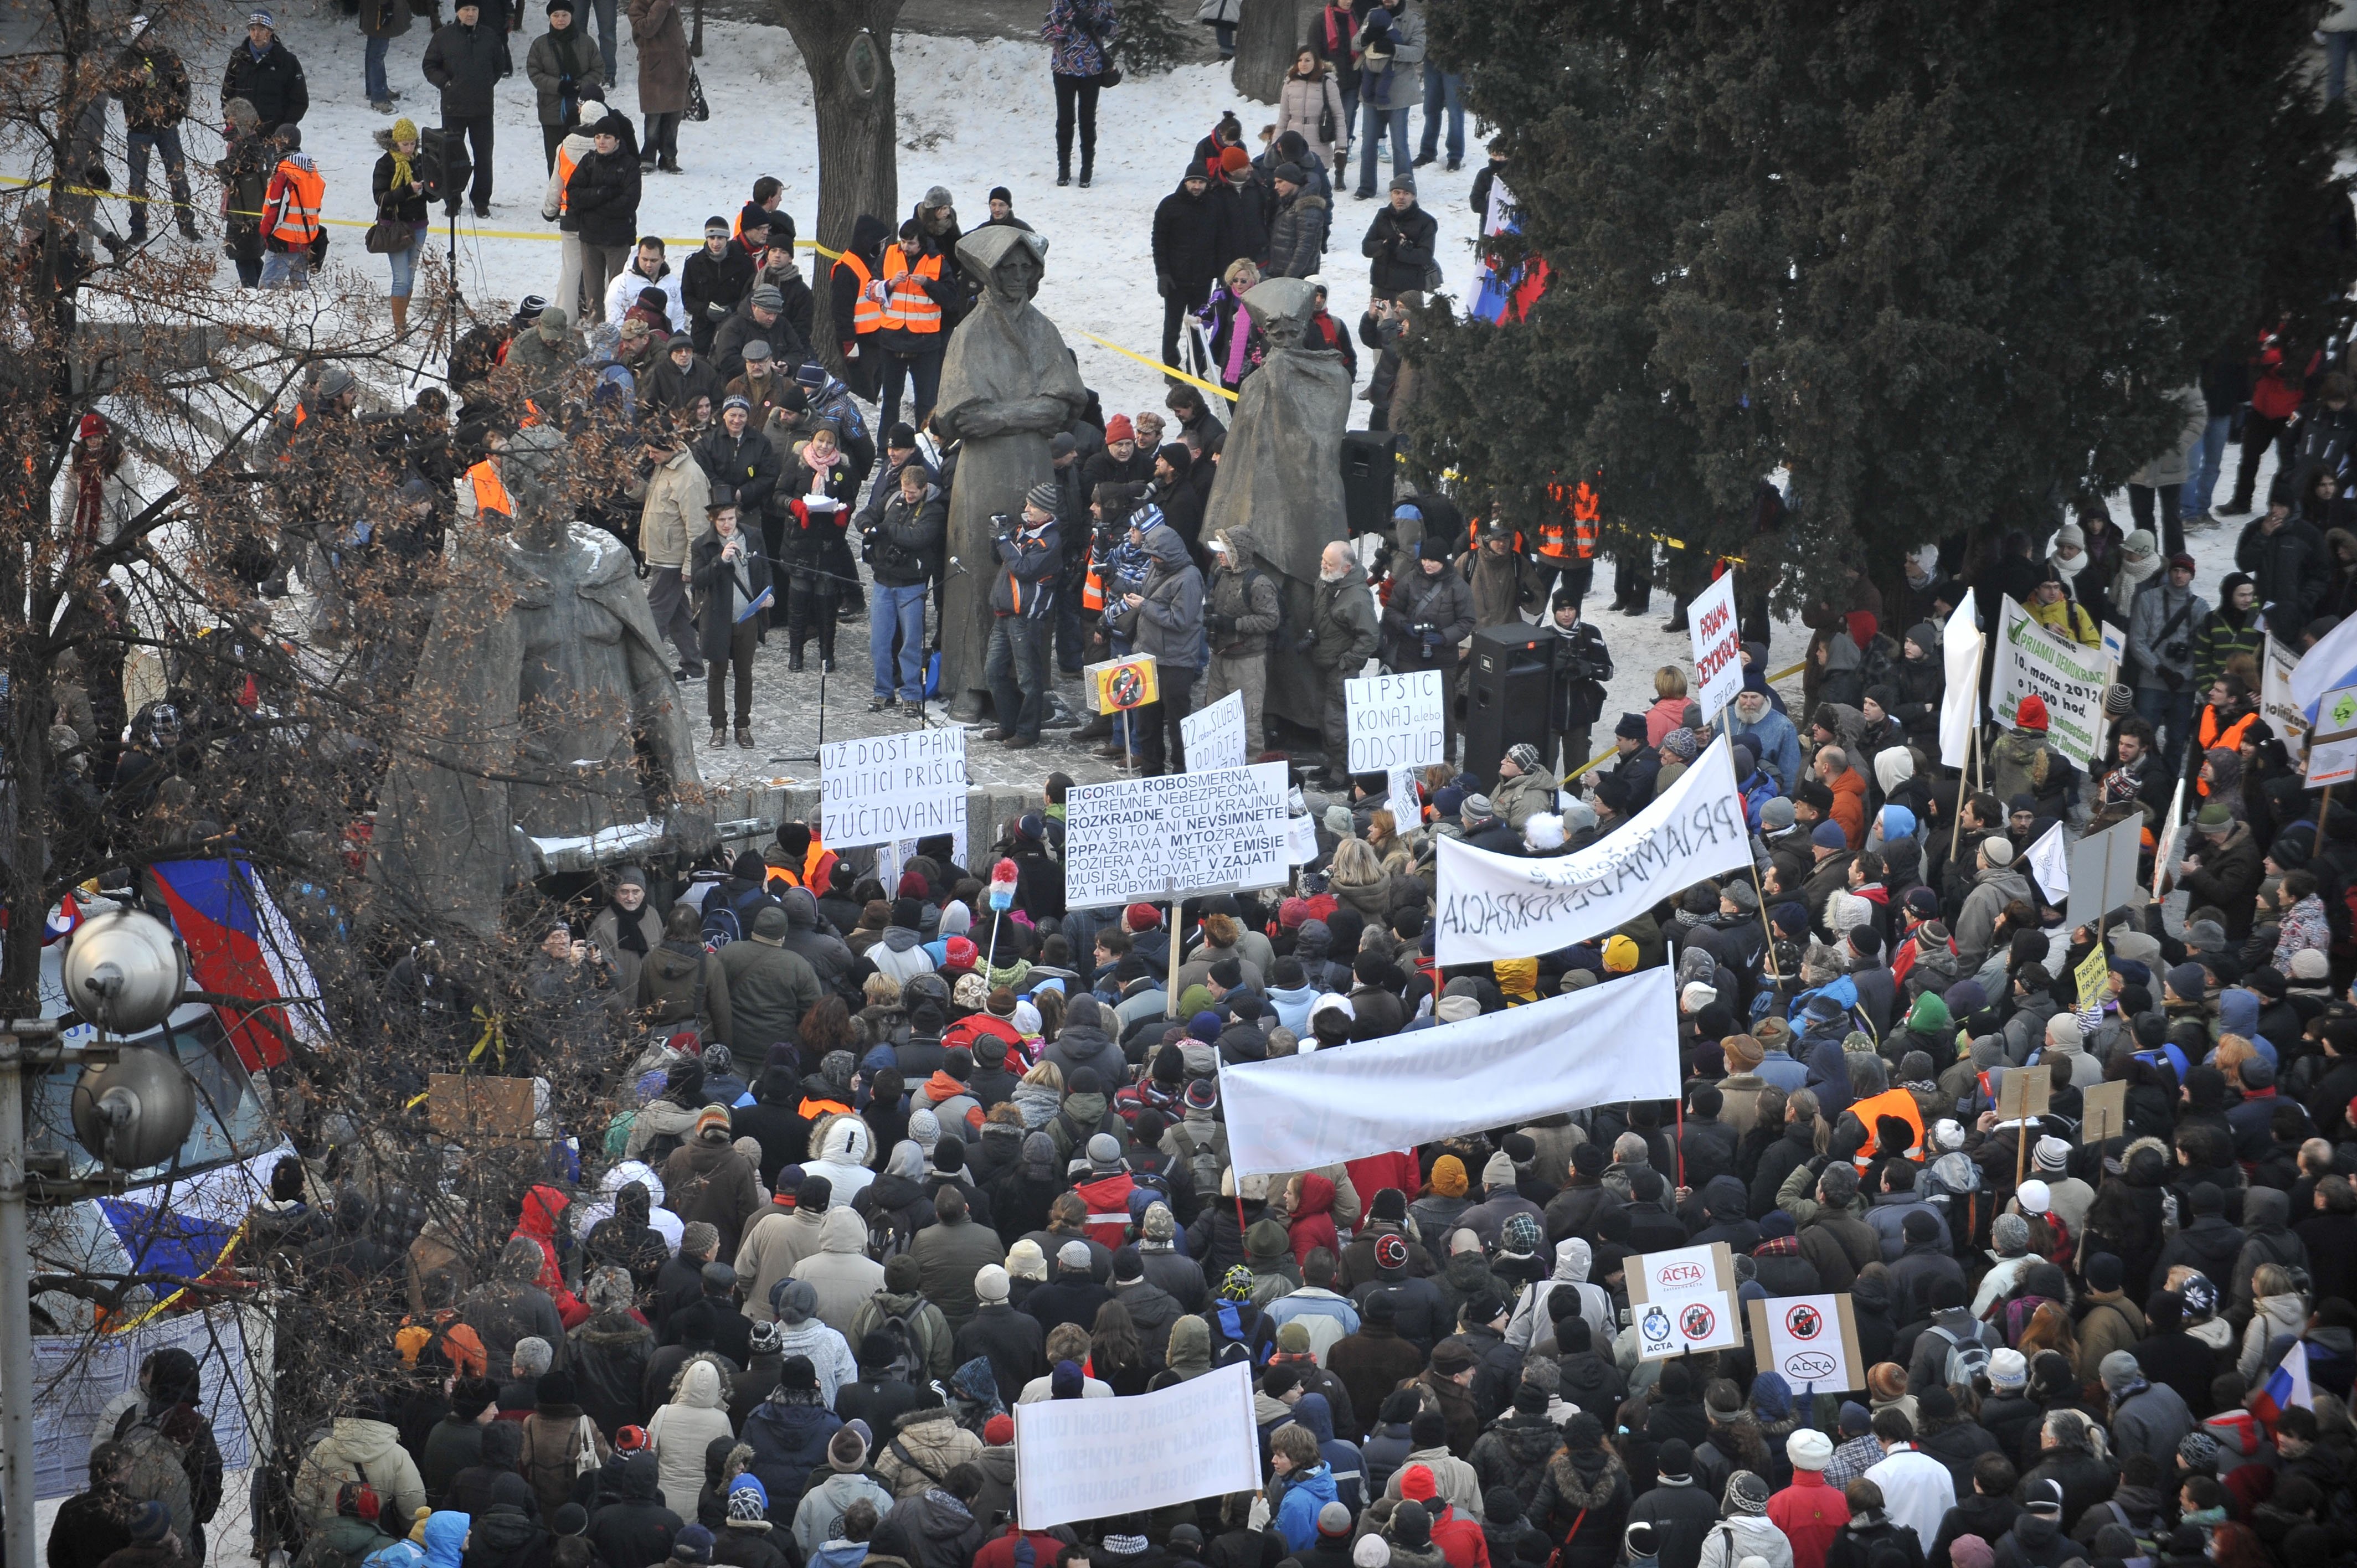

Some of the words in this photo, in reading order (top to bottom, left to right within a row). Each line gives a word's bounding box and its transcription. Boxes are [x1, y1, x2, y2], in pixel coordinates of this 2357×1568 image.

[1700, 599, 1730, 646] PRIAMA
[2020, 633, 2054, 663] PRIAMU
[2055, 653, 2106, 685] DEMOKRACI
[2014, 653, 2027, 672] 10.
[2030, 667, 2060, 692] marca
[2065, 683, 2097, 703] 2012
[2018, 678, 2024, 688] o
[2027, 681, 2057, 706] 12:00
[2062, 697, 2086, 718] hod.
[1182, 719, 1196, 749] 22
[1198, 724, 1212, 741] rokov
[1357, 706, 1411, 731] KONAJ
[1414, 704, 1440, 722] alebo
[823, 741, 847, 770] UŽ
[858, 733, 909, 765] DOSŤ
[1196, 731, 1237, 769] ODÍĎTE
[1352, 726, 1443, 770] ODSTÚP
[2059, 731, 2091, 764] Slovensk
[905, 757, 965, 788] PRIŠLO
[1068, 782, 1138, 801] FIGORILA
[1143, 767, 1252, 793] ROBOSMERNÁ
[1068, 795, 1152, 816] EXTRÉMNE
[1159, 781, 1258, 805] NEBEZPEČNÁ
[1263, 781, 1265, 792] !
[1068, 808, 1164, 831] ROZKRADNE
[1171, 800, 1210, 818] CELÚ
[1216, 793, 1280, 813] KRAJINU
[824, 792, 965, 841] ZÚČTOVANIE
[1068, 832, 1078, 844] A
[1083, 828, 1103, 842] VY
[1108, 827, 1121, 840] SI
[1128, 823, 1149, 837] TO
[1155, 820, 1180, 834] ANI
[1187, 806, 1288, 831] NEVŠIMNETE!
[881, 850, 891, 863] NA
[898, 842, 917, 855] REDA
[1068, 835, 1162, 858] PPPAŽRAVÁ
[1171, 822, 1265, 847] MÝTOŽRAVÁ
[1068, 854, 1134, 871] POŽIERA
[1141, 851, 1159, 864] AJ
[1167, 842, 1226, 861] VŠETKY
[1234, 835, 1284, 853] EMISIE
[1068, 868, 1104, 886] MUSÍ
[1110, 868, 1130, 881] SA
[1138, 858, 1201, 878] CHOVAŤ
[1208, 858, 1218, 870] V
[1223, 848, 1275, 868] ZAJATÍ
[1068, 886, 1088, 900] ZA
[1095, 878, 1165, 896] HRUBÝMI
[1174, 868, 1242, 888] MREŽAMI
[1248, 866, 1250, 879] !
[2076, 950, 2103, 981] TRESTNO
[2081, 964, 2106, 993] PRÁVNA
[1662, 1265, 1701, 1282] ACTA
[1646, 1342, 1674, 1352] ACTA
[1791, 1361, 1833, 1371] ACTA
